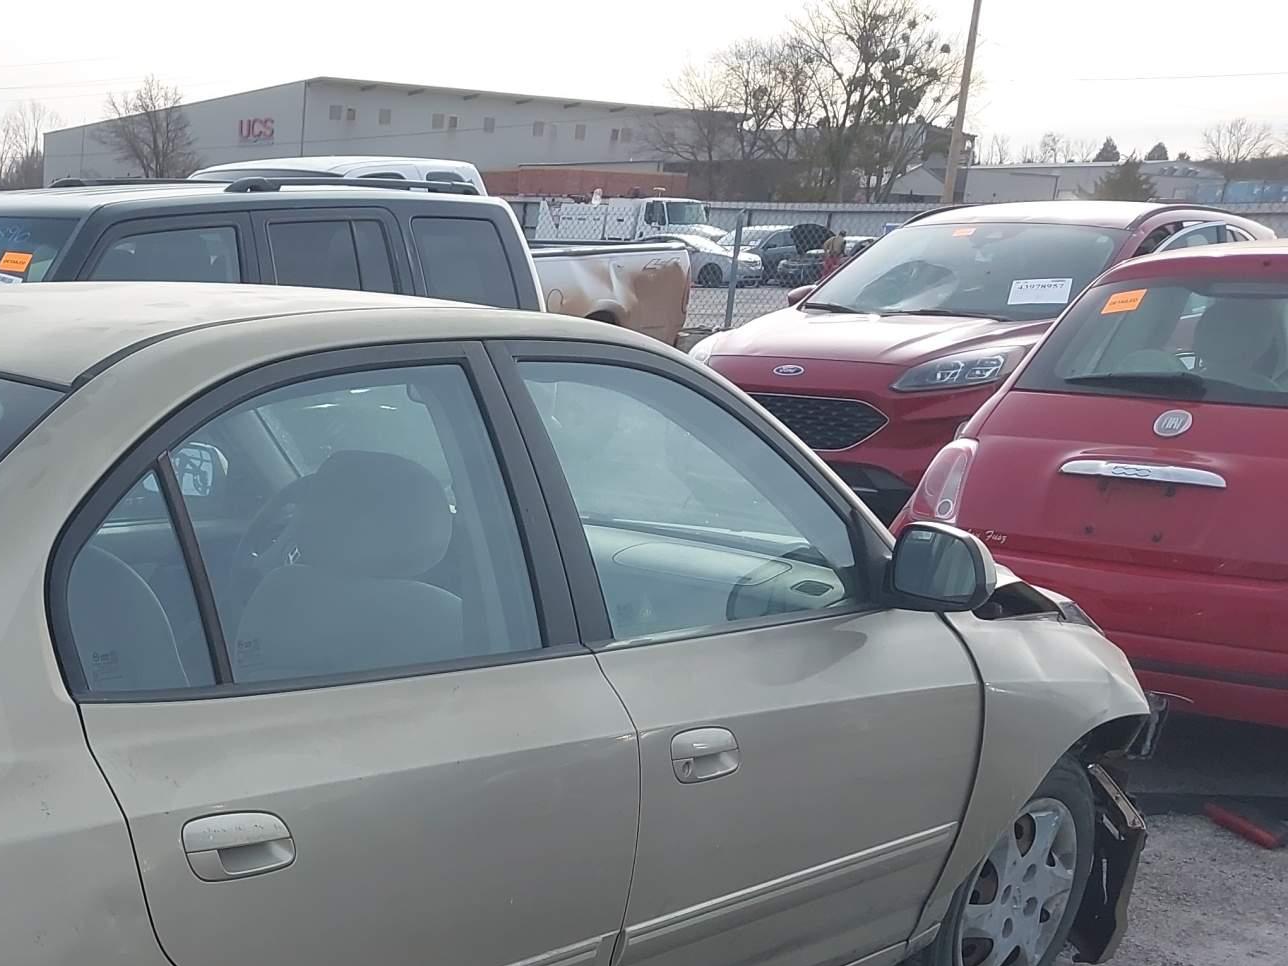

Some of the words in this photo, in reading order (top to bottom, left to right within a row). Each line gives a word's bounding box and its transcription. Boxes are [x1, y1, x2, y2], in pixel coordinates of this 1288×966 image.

[239, 118, 274, 138] UCS
[1161, 416, 1185, 430] FIAT
[1112, 466, 1152, 478] 500
